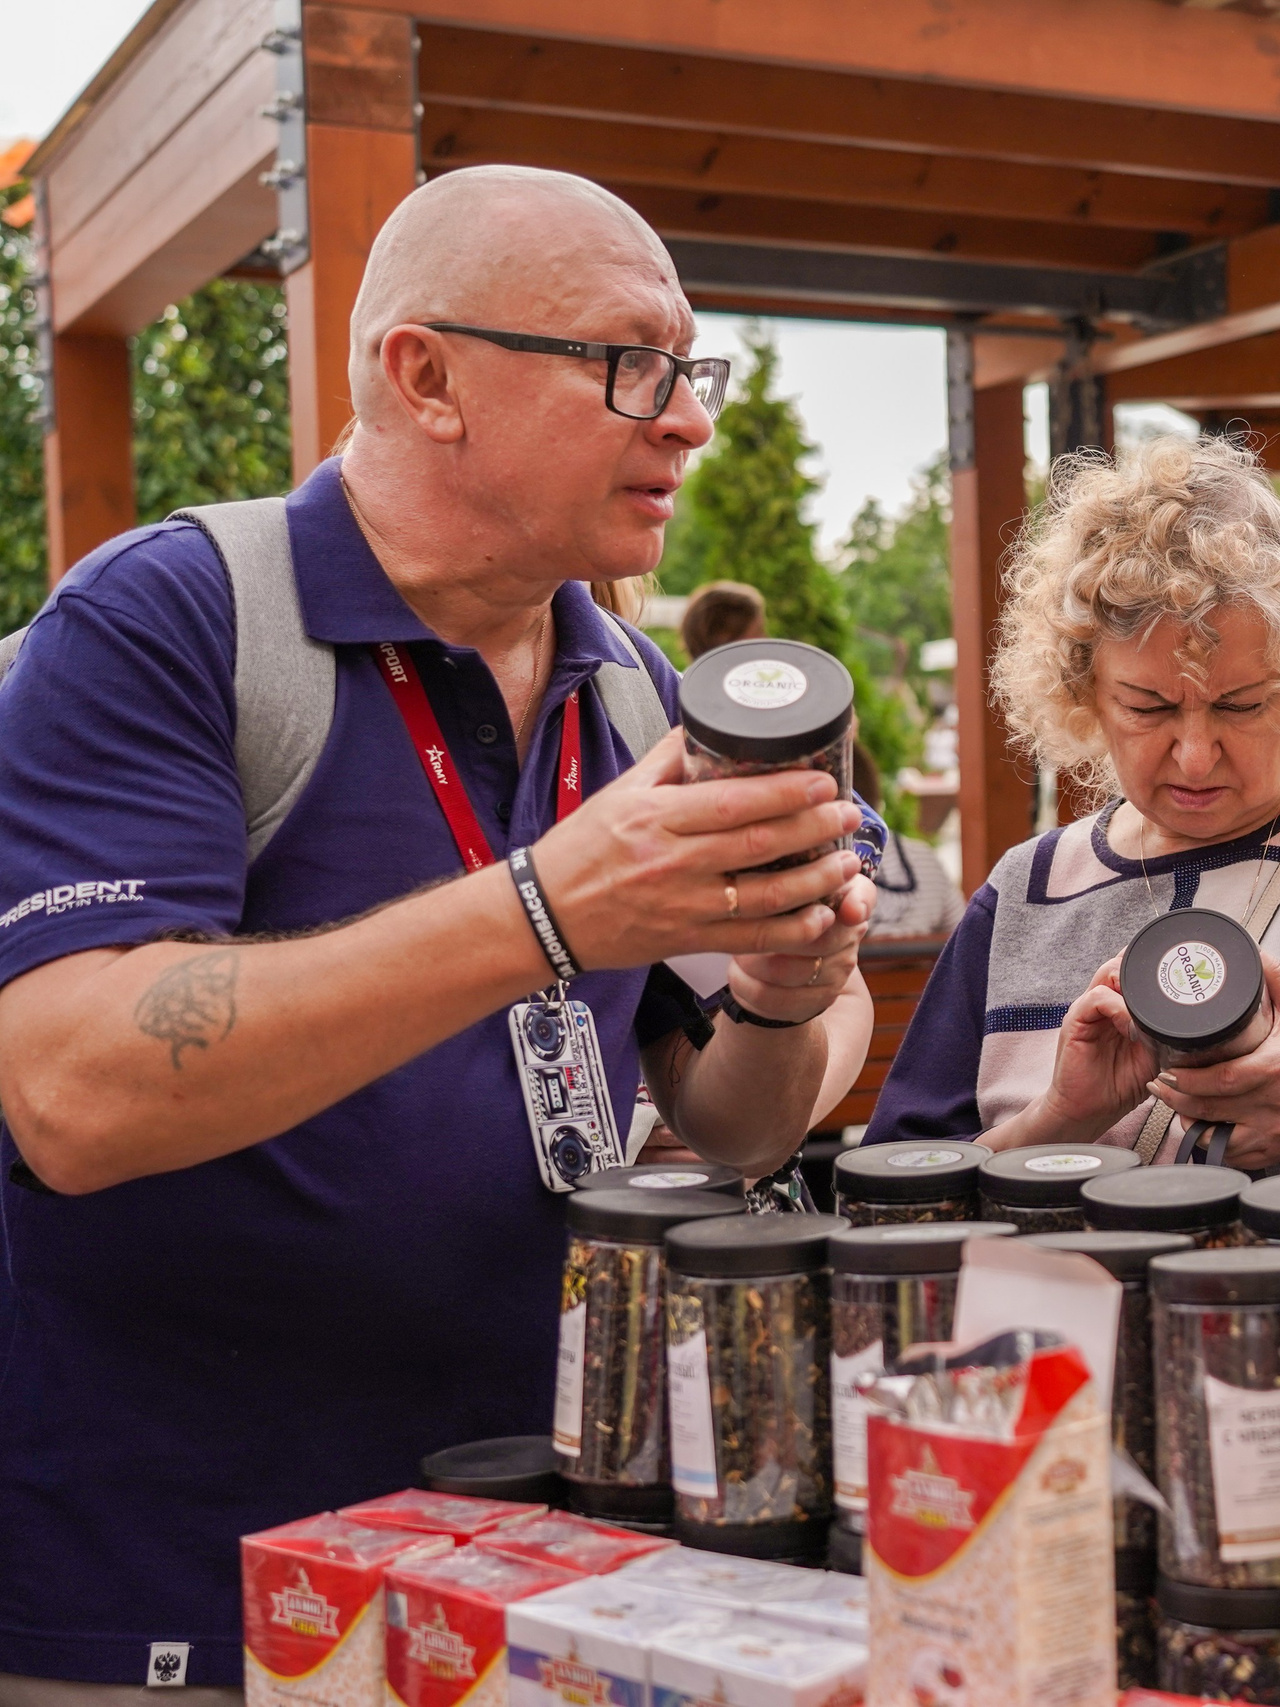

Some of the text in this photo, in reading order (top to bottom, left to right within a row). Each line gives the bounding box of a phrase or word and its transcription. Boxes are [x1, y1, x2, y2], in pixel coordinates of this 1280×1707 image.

[728, 678, 804, 690] ORGANIC
[46, 893, 144, 916] PUTIN TEAM
[1160, 961, 1180, 1000] PRODUCTS
[1177, 946, 1206, 1002] ORGANIC
[1199, 945, 1223, 987] 100% NATURAL
